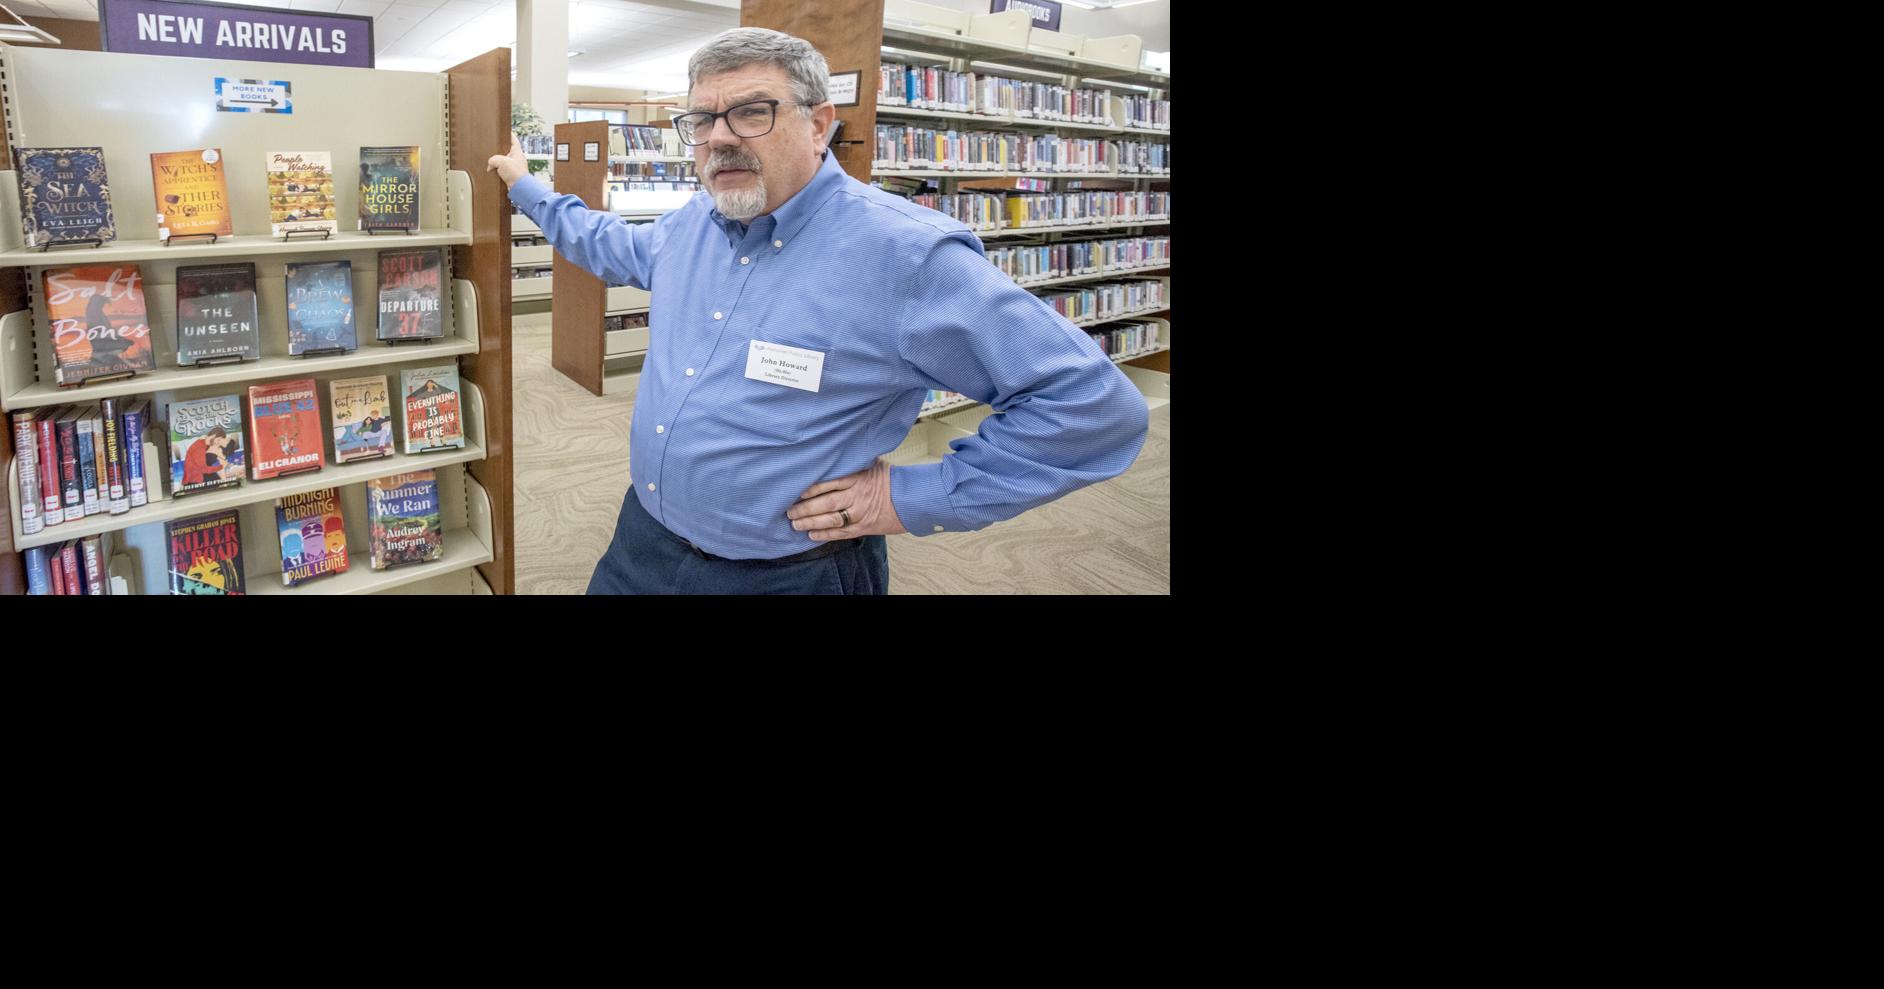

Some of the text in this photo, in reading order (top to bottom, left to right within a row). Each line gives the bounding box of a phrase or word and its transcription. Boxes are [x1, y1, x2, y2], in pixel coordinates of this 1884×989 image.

[137, 13, 347, 54] NEW ARRIVALS
[274, 154, 303, 163] People
[288, 163, 326, 172] Watching
[46, 181, 91, 202] SEA
[362, 184, 417, 193] MIRROR
[366, 194, 414, 203] HOUSE
[37, 201, 103, 214] WITCH
[370, 204, 410, 214] GIRLS
[382, 255, 424, 273] SCOTT
[47, 268, 143, 305] Salt
[201, 308, 233, 318] THE
[381, 299, 440, 312] DEPARTURE
[52, 318, 151, 350] Bones
[184, 322, 250, 336] UNSEEN
[761, 356, 808, 371] John Howard
[254, 391, 313, 405] MISSISSIPPI
[407, 392, 456, 411] EVERYTHING
[177, 400, 239, 420] SCOTCH
[428, 407, 438, 416] IS
[105, 419, 115, 431] JOY
[175, 416, 232, 436] ROCKS
[412, 413, 455, 432] PROBABLY
[424, 427, 445, 440] FINE
[16, 423, 36, 485] PARK AVENUE
[107, 431, 118, 463] FIELDING
[259, 453, 319, 470] ELI CRANOR
[285, 499, 334, 522] BURNING
[377, 500, 431, 516] We Ran
[172, 524, 238, 554] KILLER
[387, 526, 425, 539] Audrey
[387, 537, 425, 551] Ingram
[191, 542, 239, 569] ROAD
[288, 565, 313, 581] PAUL
